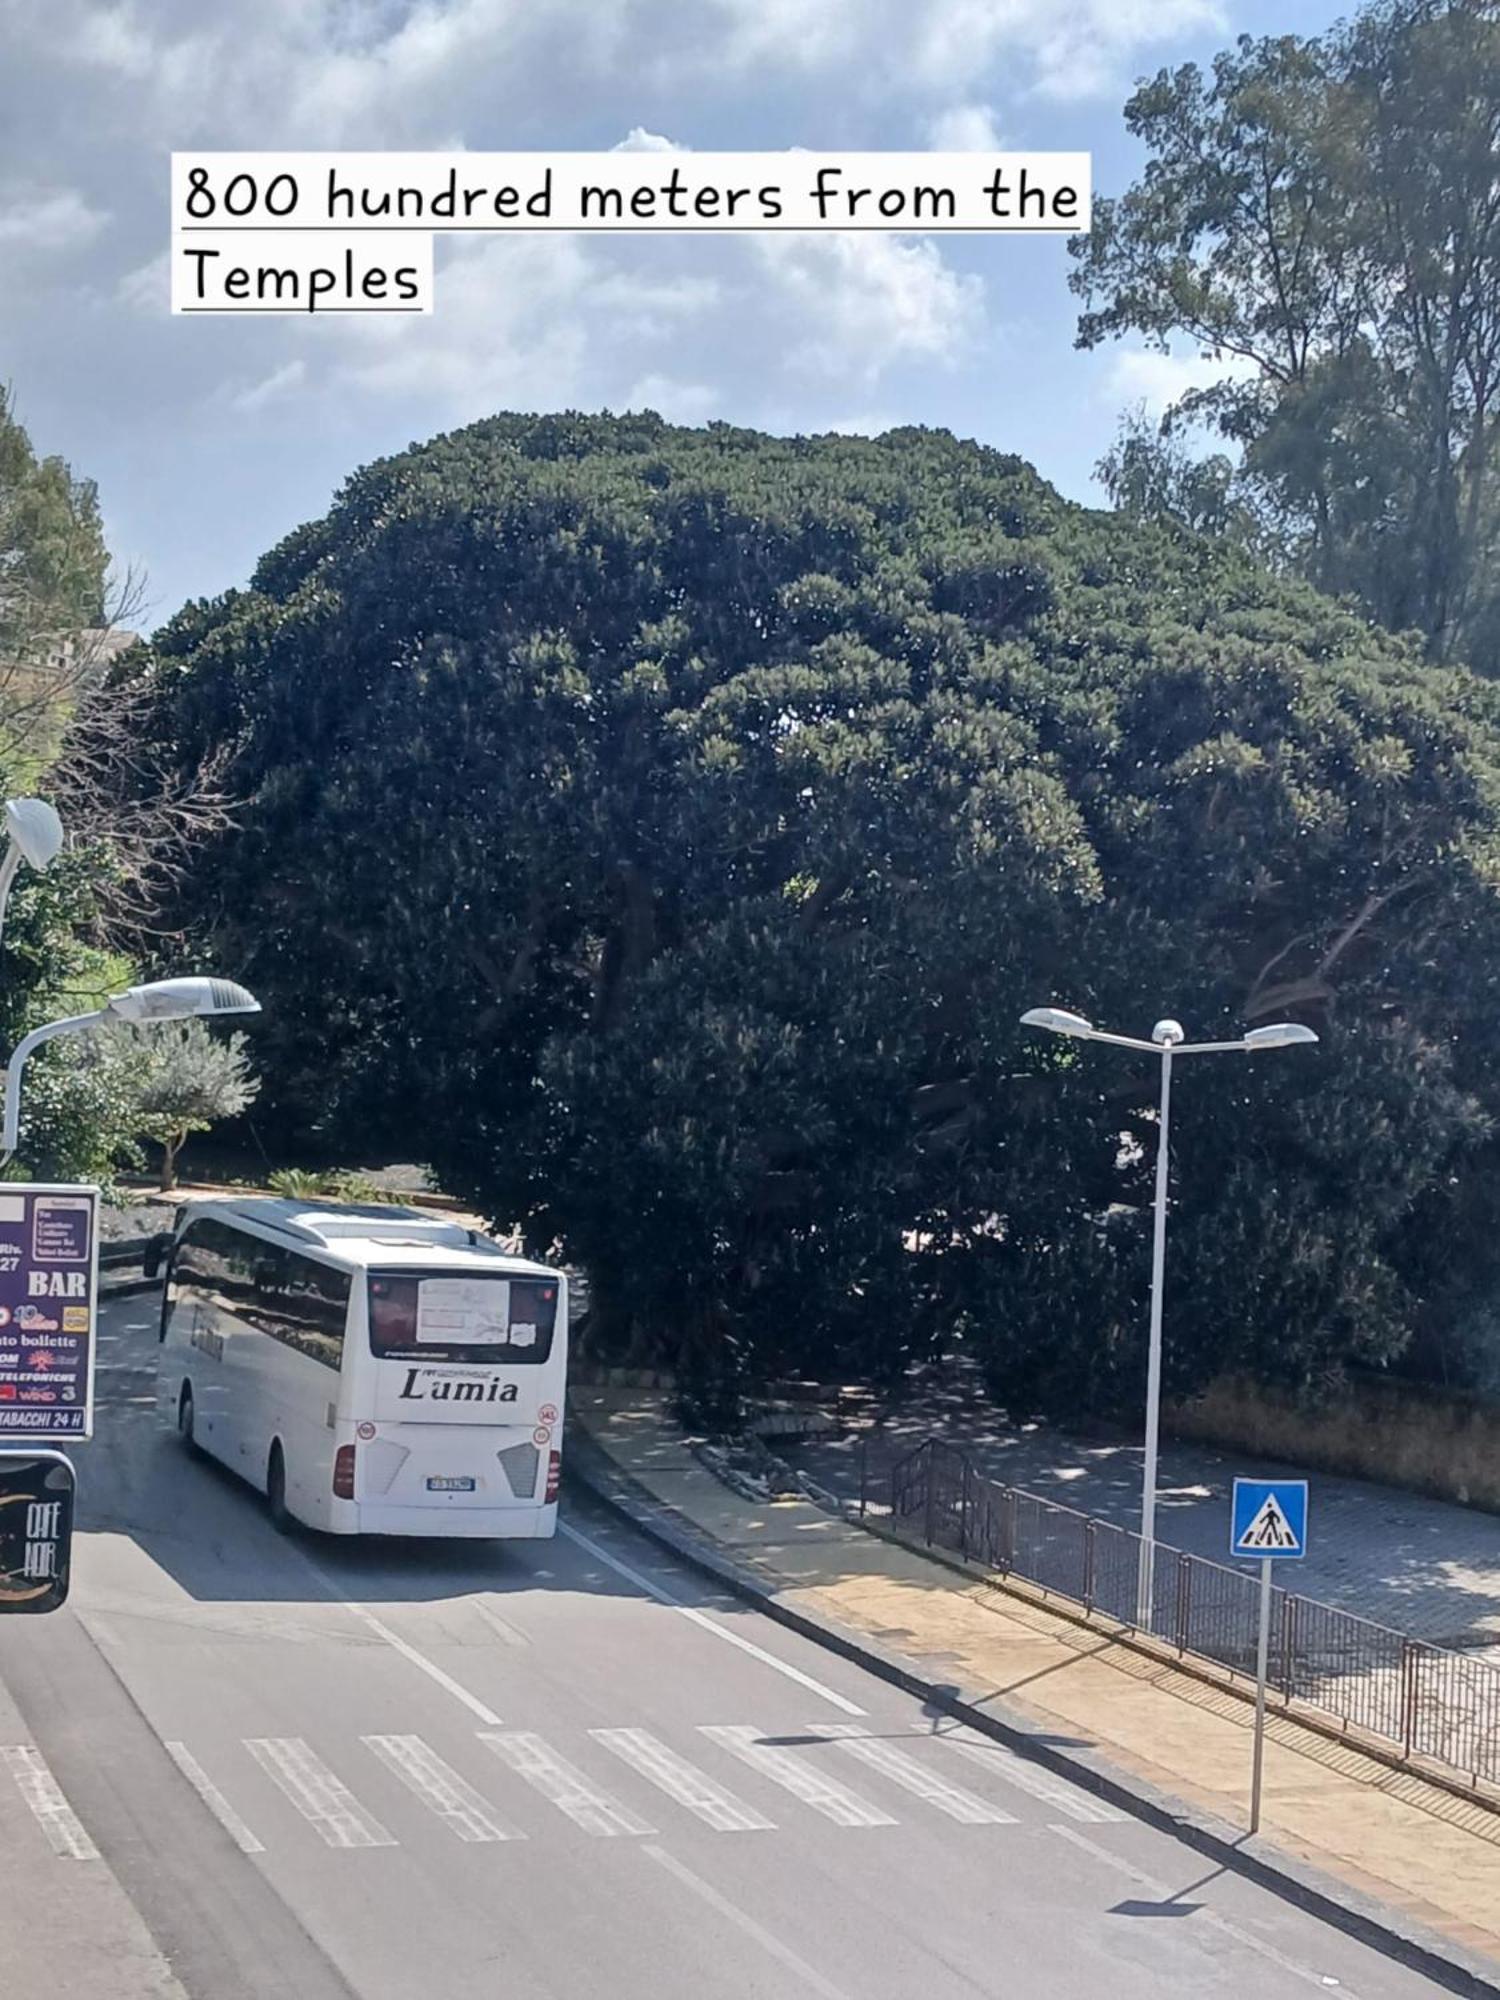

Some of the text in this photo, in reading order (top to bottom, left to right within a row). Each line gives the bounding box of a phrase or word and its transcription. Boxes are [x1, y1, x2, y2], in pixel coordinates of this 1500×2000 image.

[28, 1271, 87, 1297] BAR
[21, 1334, 77, 1347] bollette
[399, 1369, 519, 1402] Lumia
[0, 1412, 82, 1427] TABACCHI 24 H
